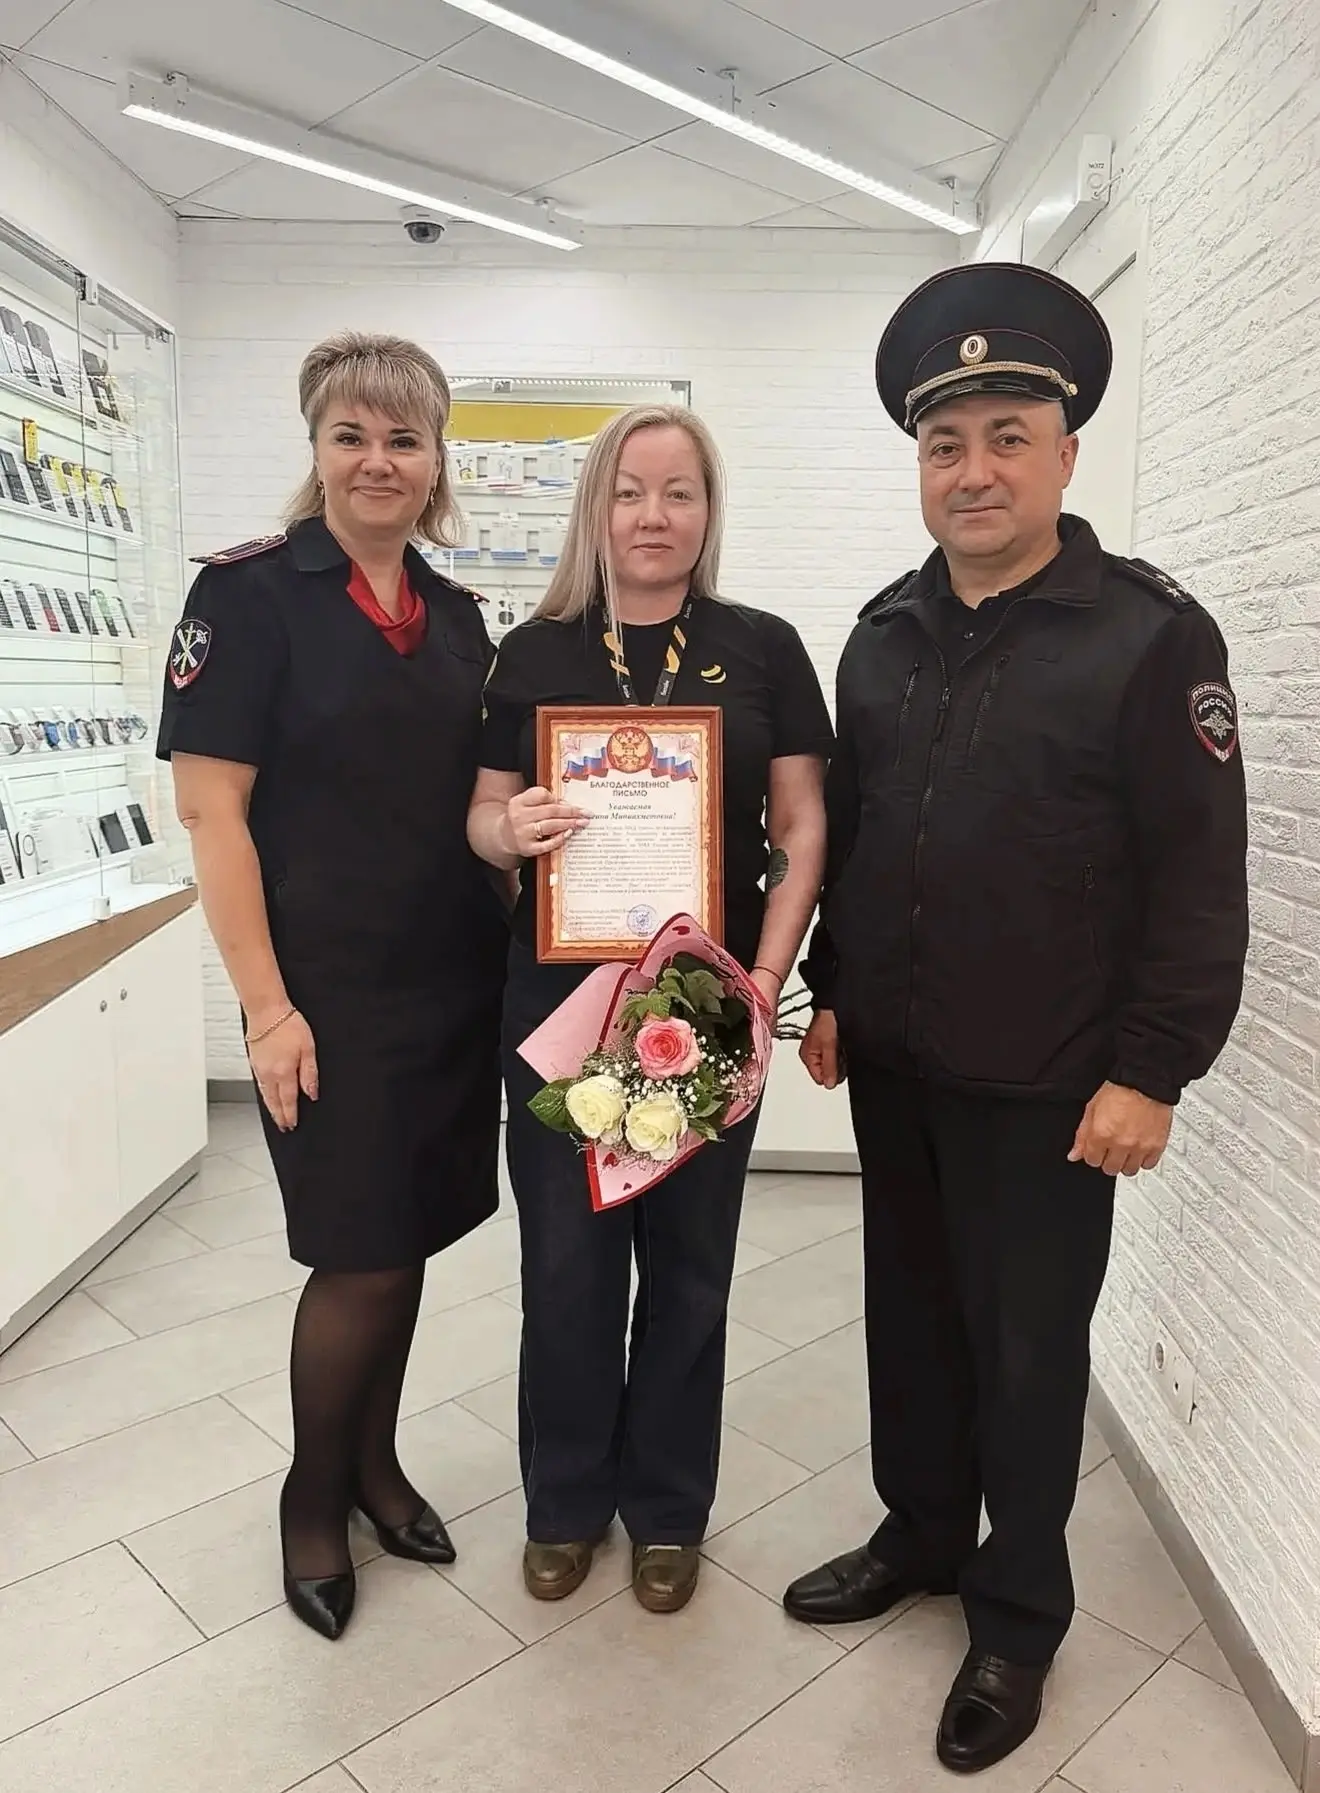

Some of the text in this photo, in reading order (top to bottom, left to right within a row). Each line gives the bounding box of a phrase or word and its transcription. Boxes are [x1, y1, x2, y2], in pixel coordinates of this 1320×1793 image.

[1191, 684, 1235, 705] ПОЛИЦИЯ
[1197, 697, 1233, 717] РОССИИ
[589, 780, 671, 789] БЛАГОДАРСТВЕННОЕ
[612, 789, 648, 798] ПИСЬМО
[608, 802, 652, 811] Уважаемая
